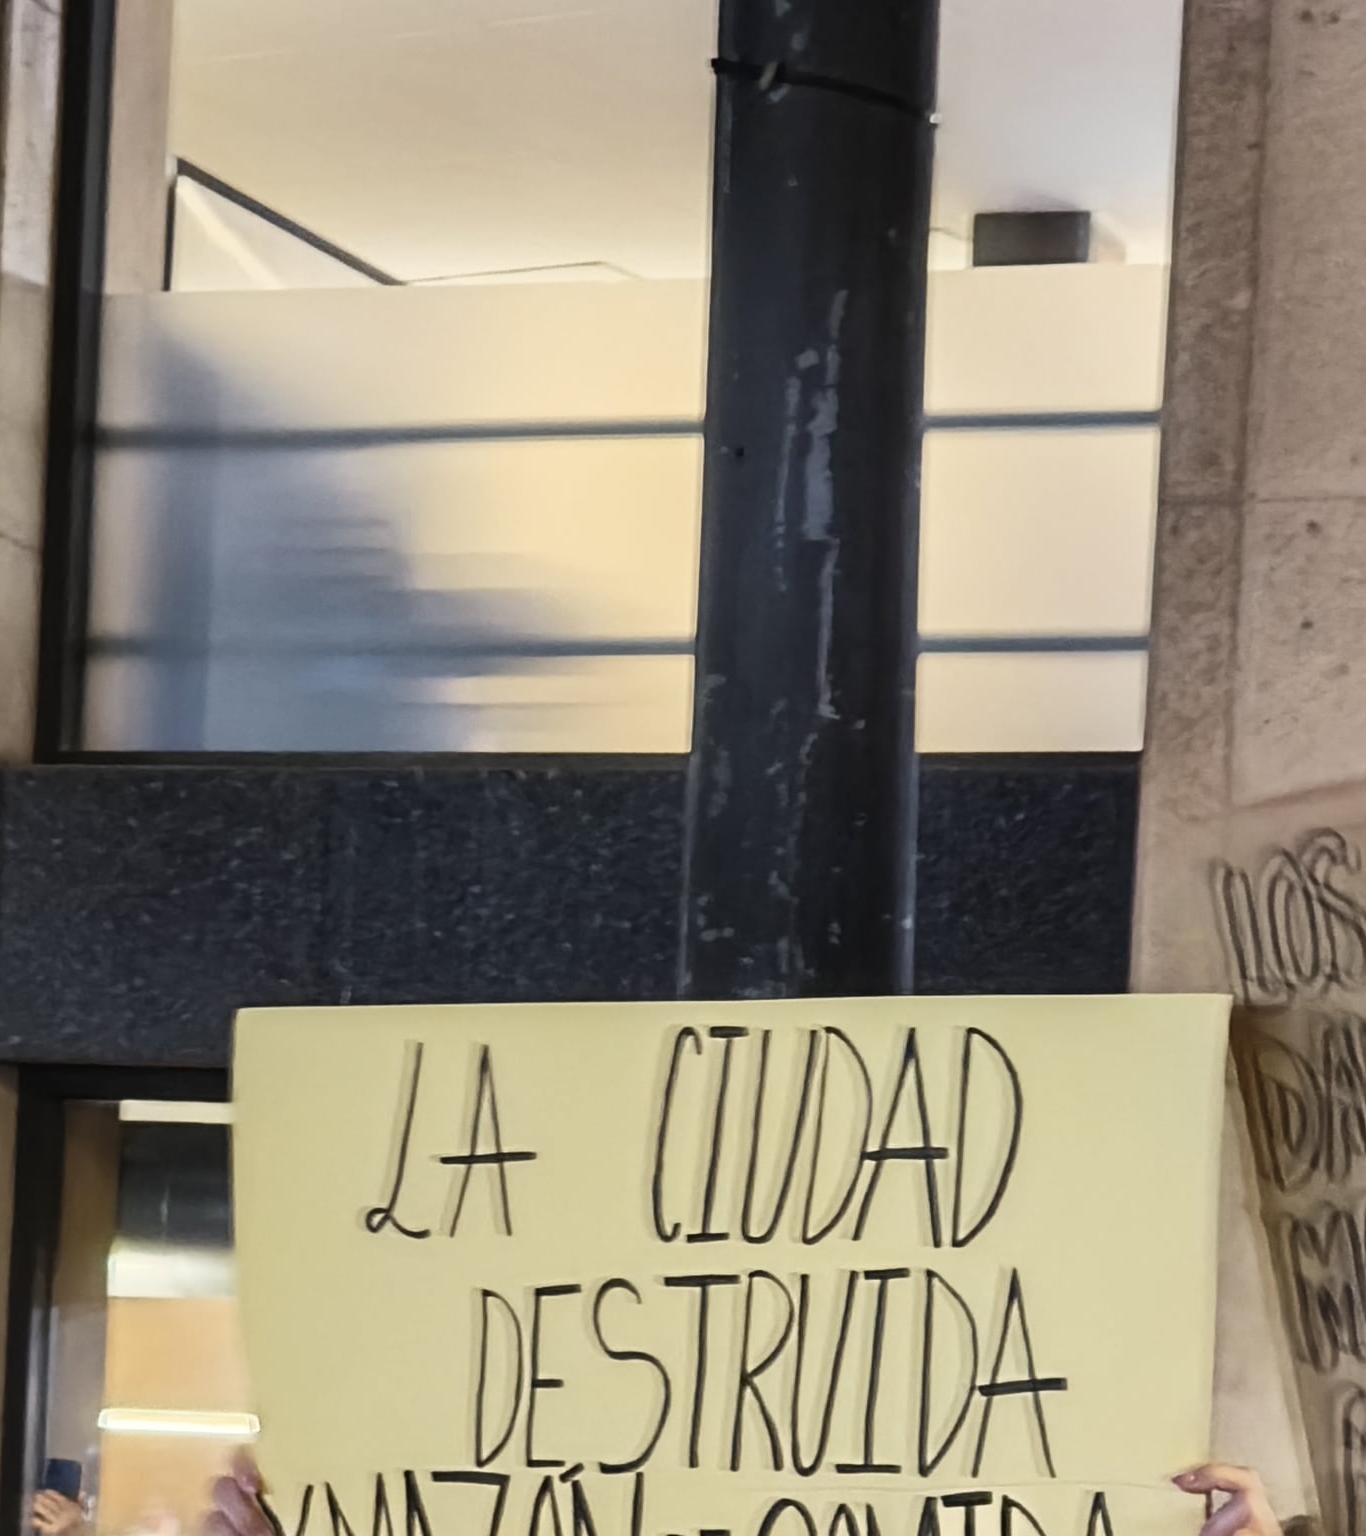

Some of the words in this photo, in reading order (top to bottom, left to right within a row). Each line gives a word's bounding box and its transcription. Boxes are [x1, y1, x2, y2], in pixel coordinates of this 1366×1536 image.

[365, 1039, 539, 1239] LA
[651, 1025, 1025, 1247] CIUDAD
[472, 1269, 1069, 1477] DESTRUIDA
